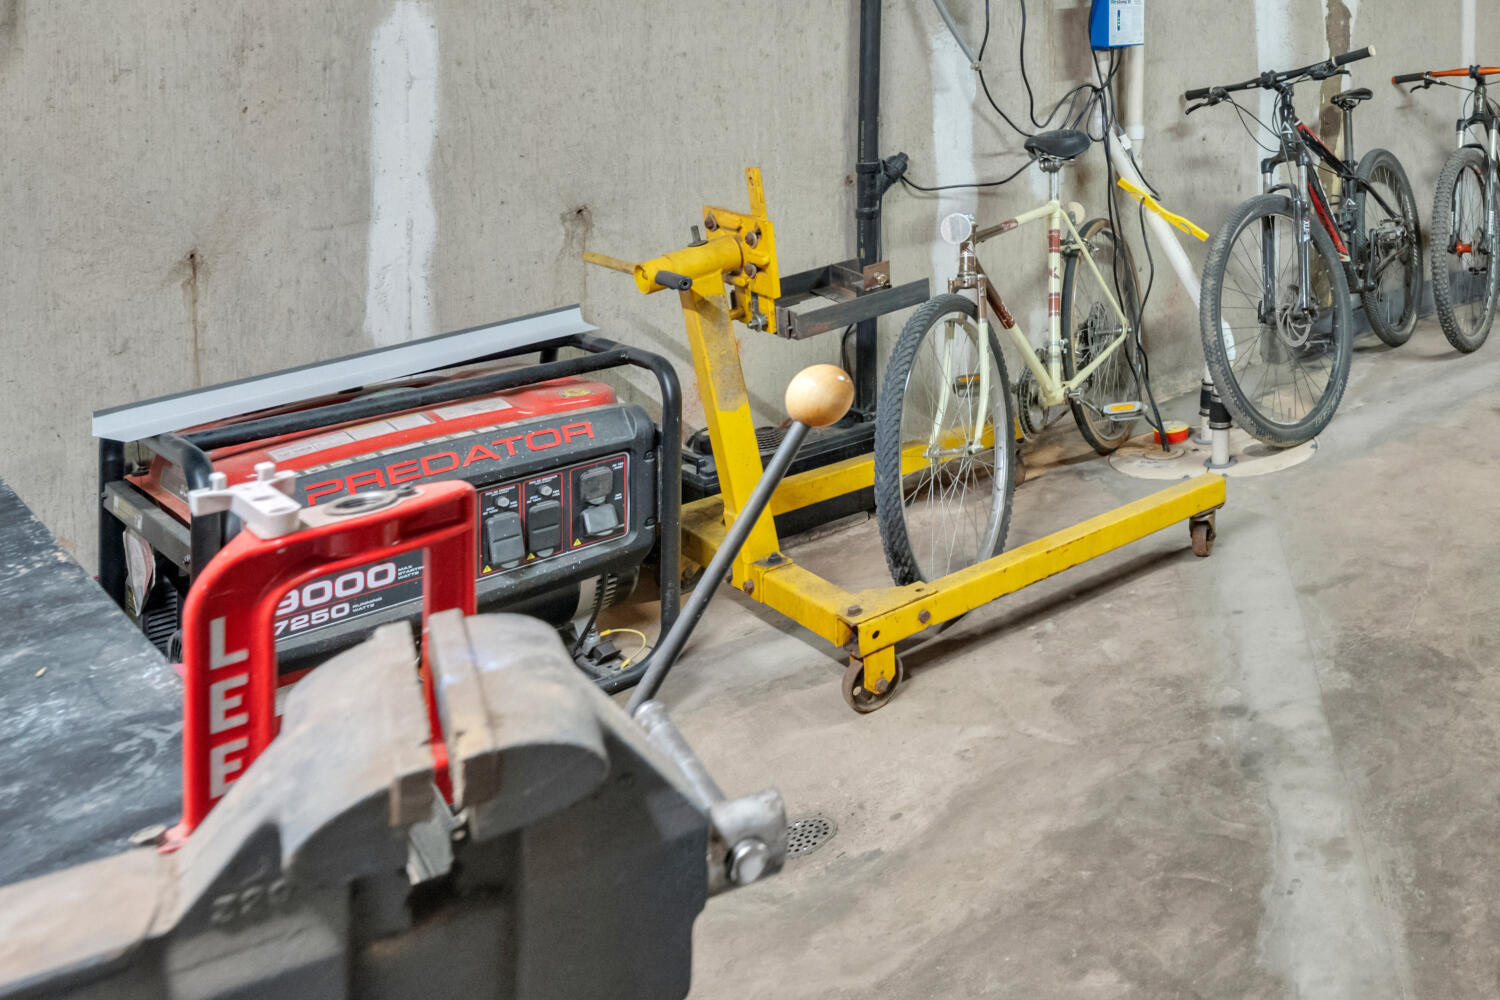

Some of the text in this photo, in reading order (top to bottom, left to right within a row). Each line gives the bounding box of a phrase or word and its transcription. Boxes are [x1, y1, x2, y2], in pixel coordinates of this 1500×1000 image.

[304, 420, 595, 506] PREDATOR
[273, 602, 351, 637] 7250
[275, 561, 397, 617] 9000
[209, 615, 250, 800] LEE
